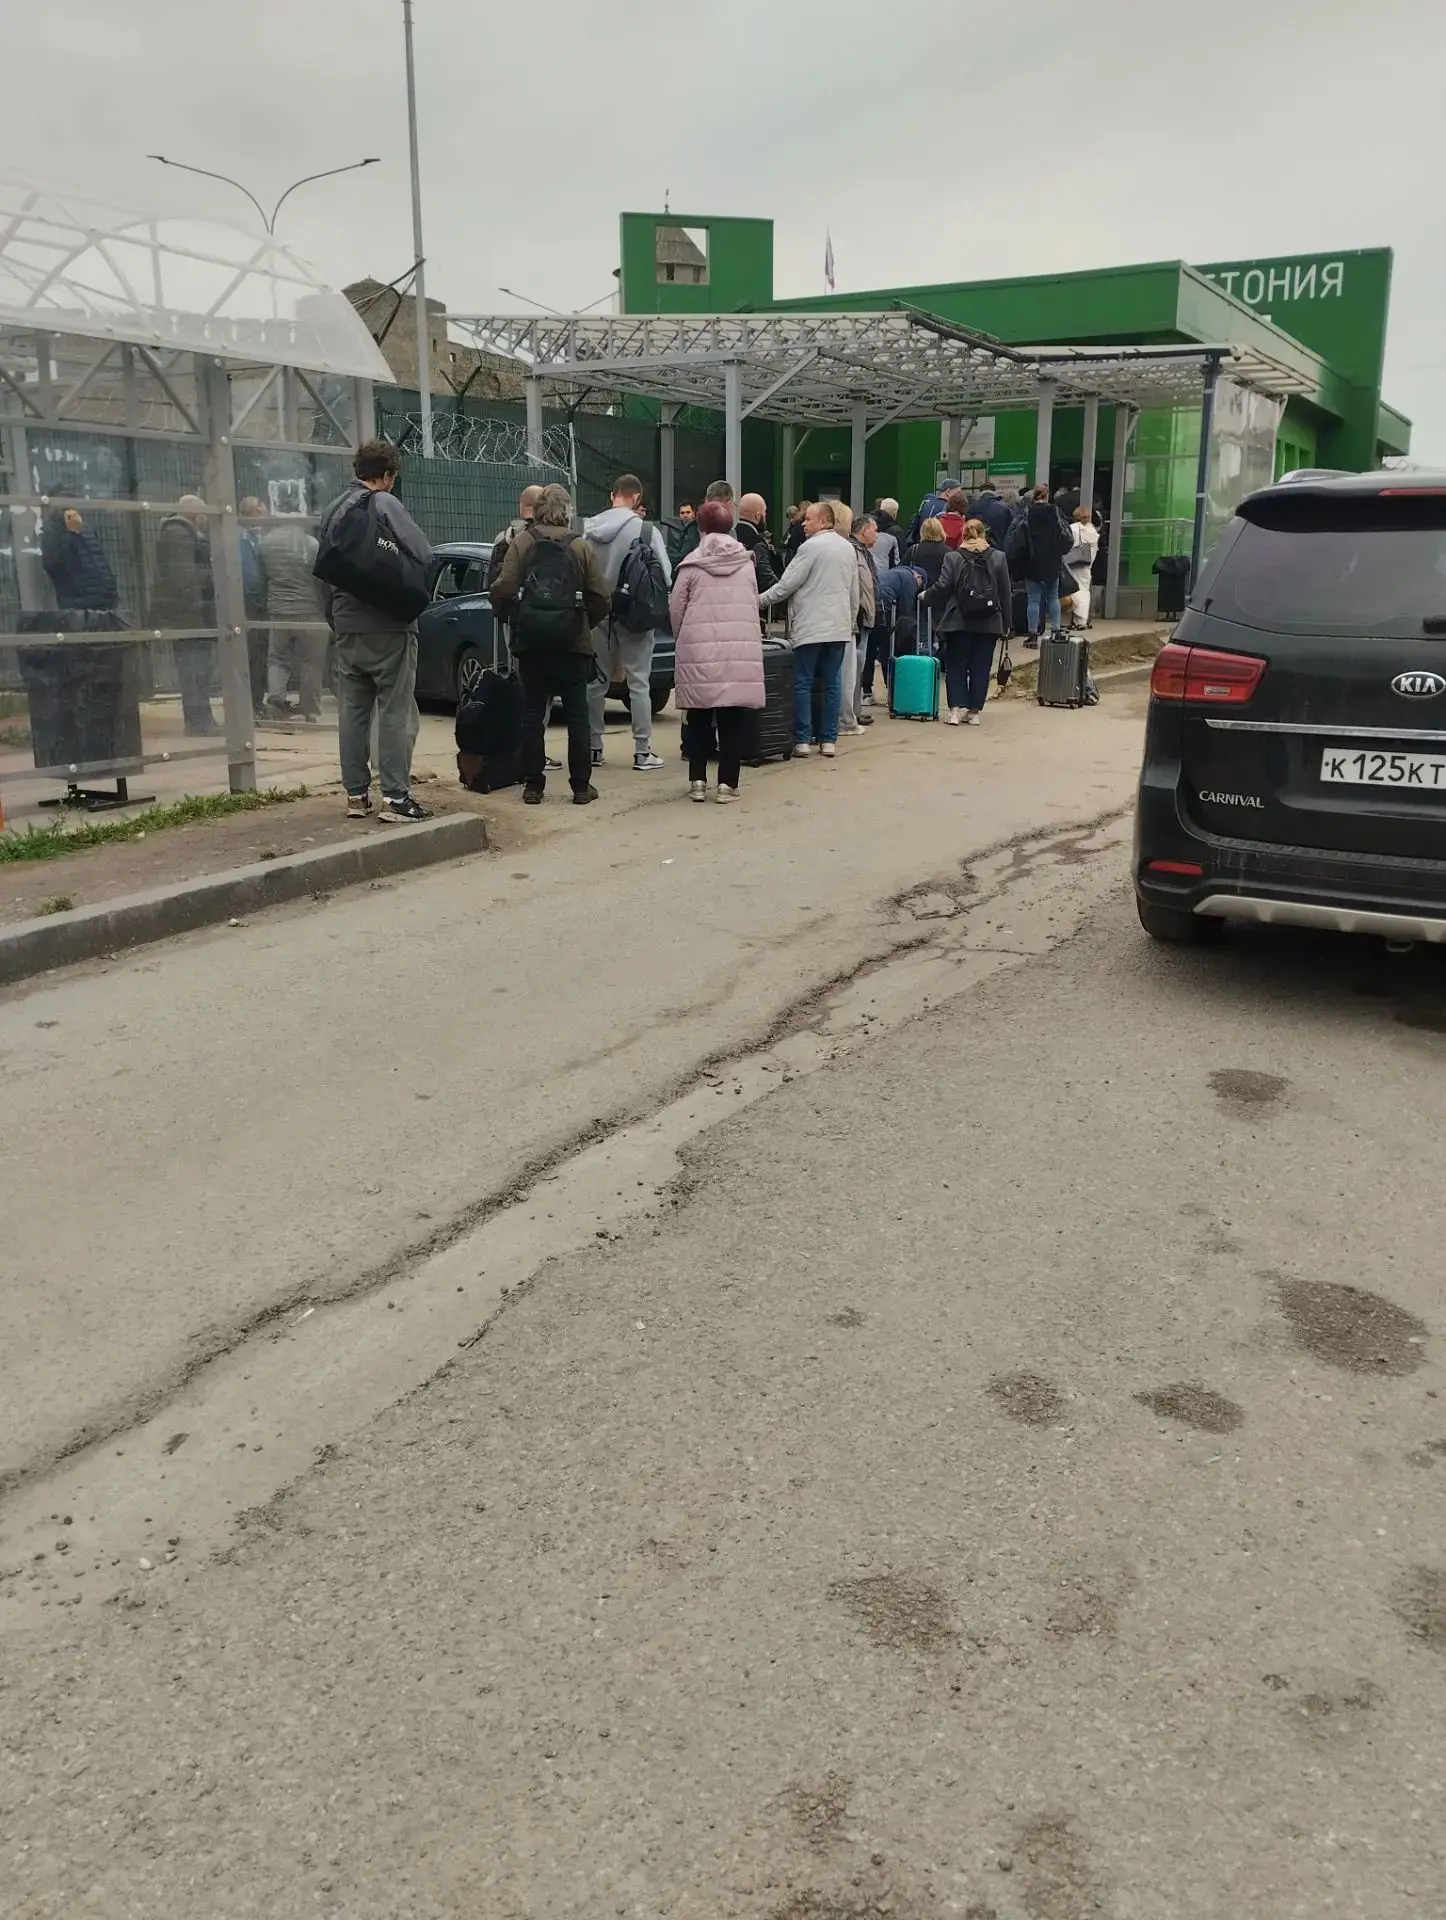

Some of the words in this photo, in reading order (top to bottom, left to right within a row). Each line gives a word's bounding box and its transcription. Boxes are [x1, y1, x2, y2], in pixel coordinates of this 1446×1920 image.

[1204, 261, 1344, 304] ТОНИЯ
[1400, 677, 1437, 693] KIA
[1199, 790, 1264, 808] CARNIVAL
